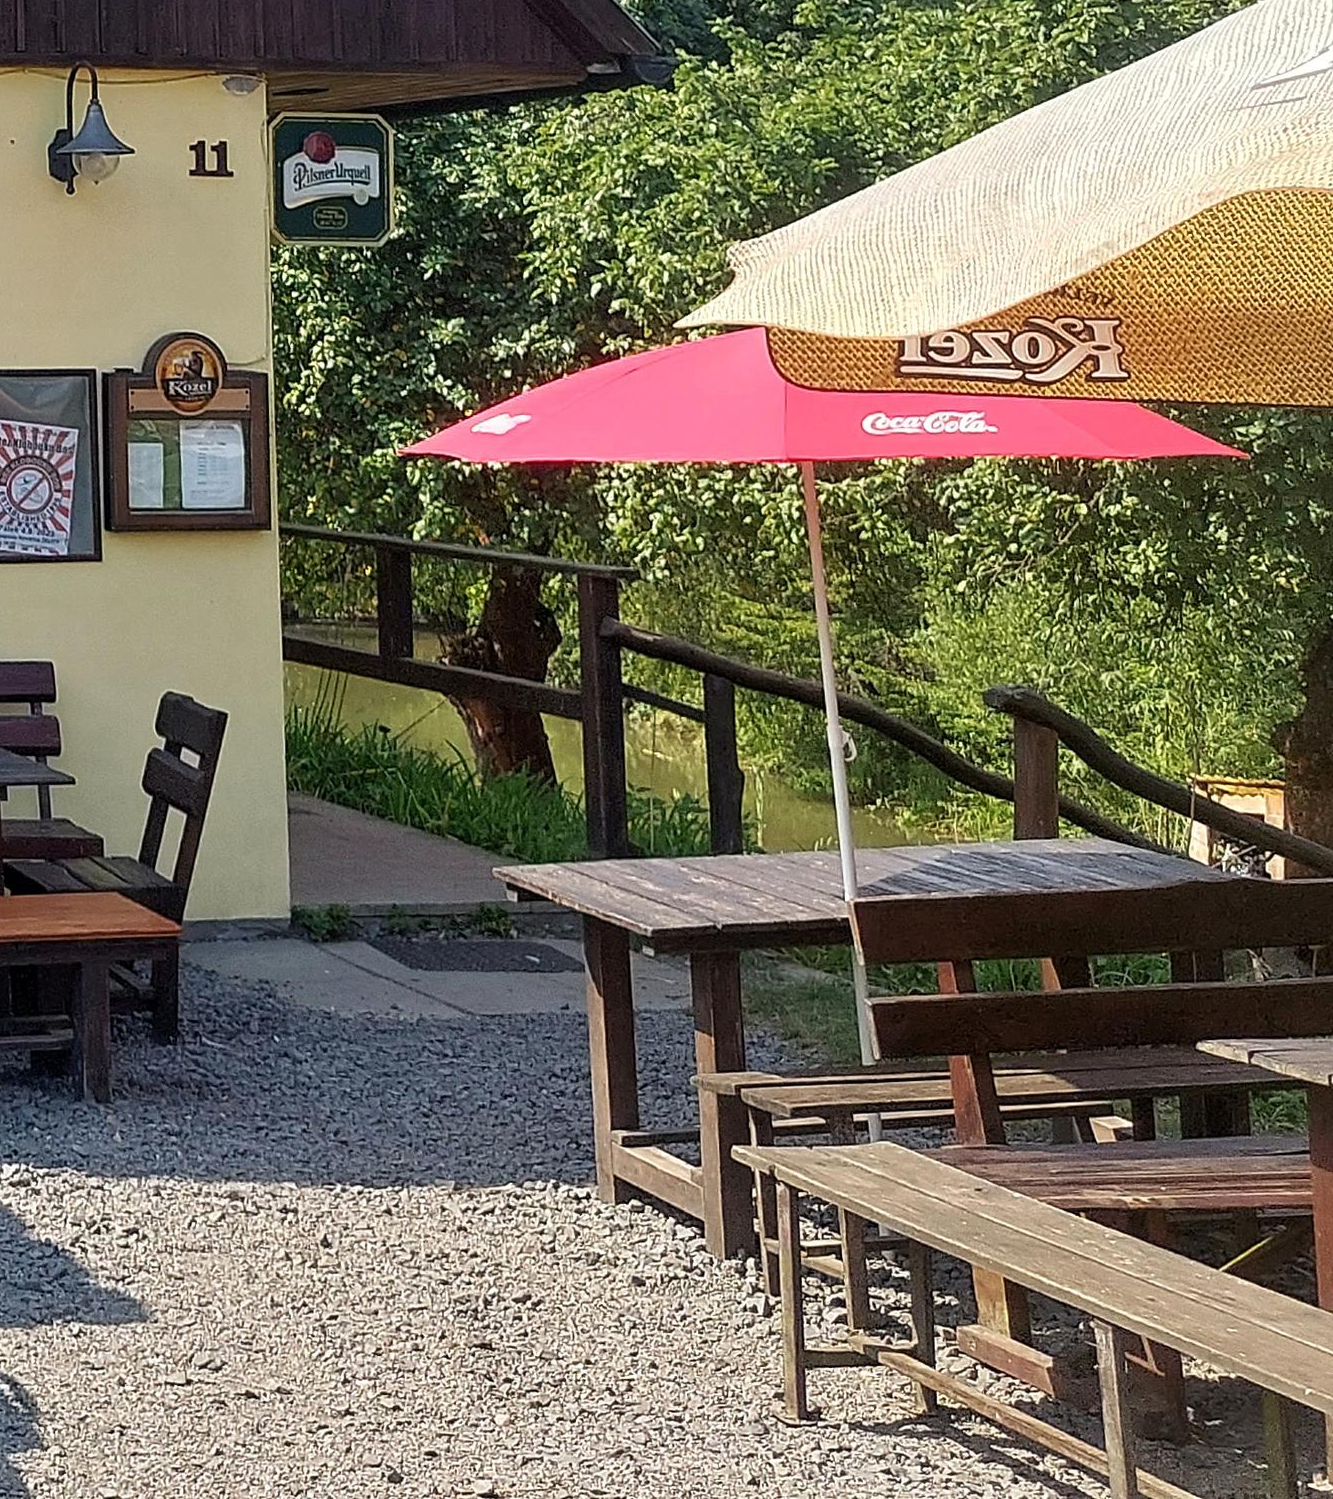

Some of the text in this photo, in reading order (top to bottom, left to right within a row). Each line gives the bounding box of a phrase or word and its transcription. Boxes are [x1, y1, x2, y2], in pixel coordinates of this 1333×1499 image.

[188, 139, 234, 177] 11
[293, 162, 371, 191] Pilsner Urquell
[167, 379, 213, 397] Kozel
[861, 409, 999, 435] Coca-Cola
